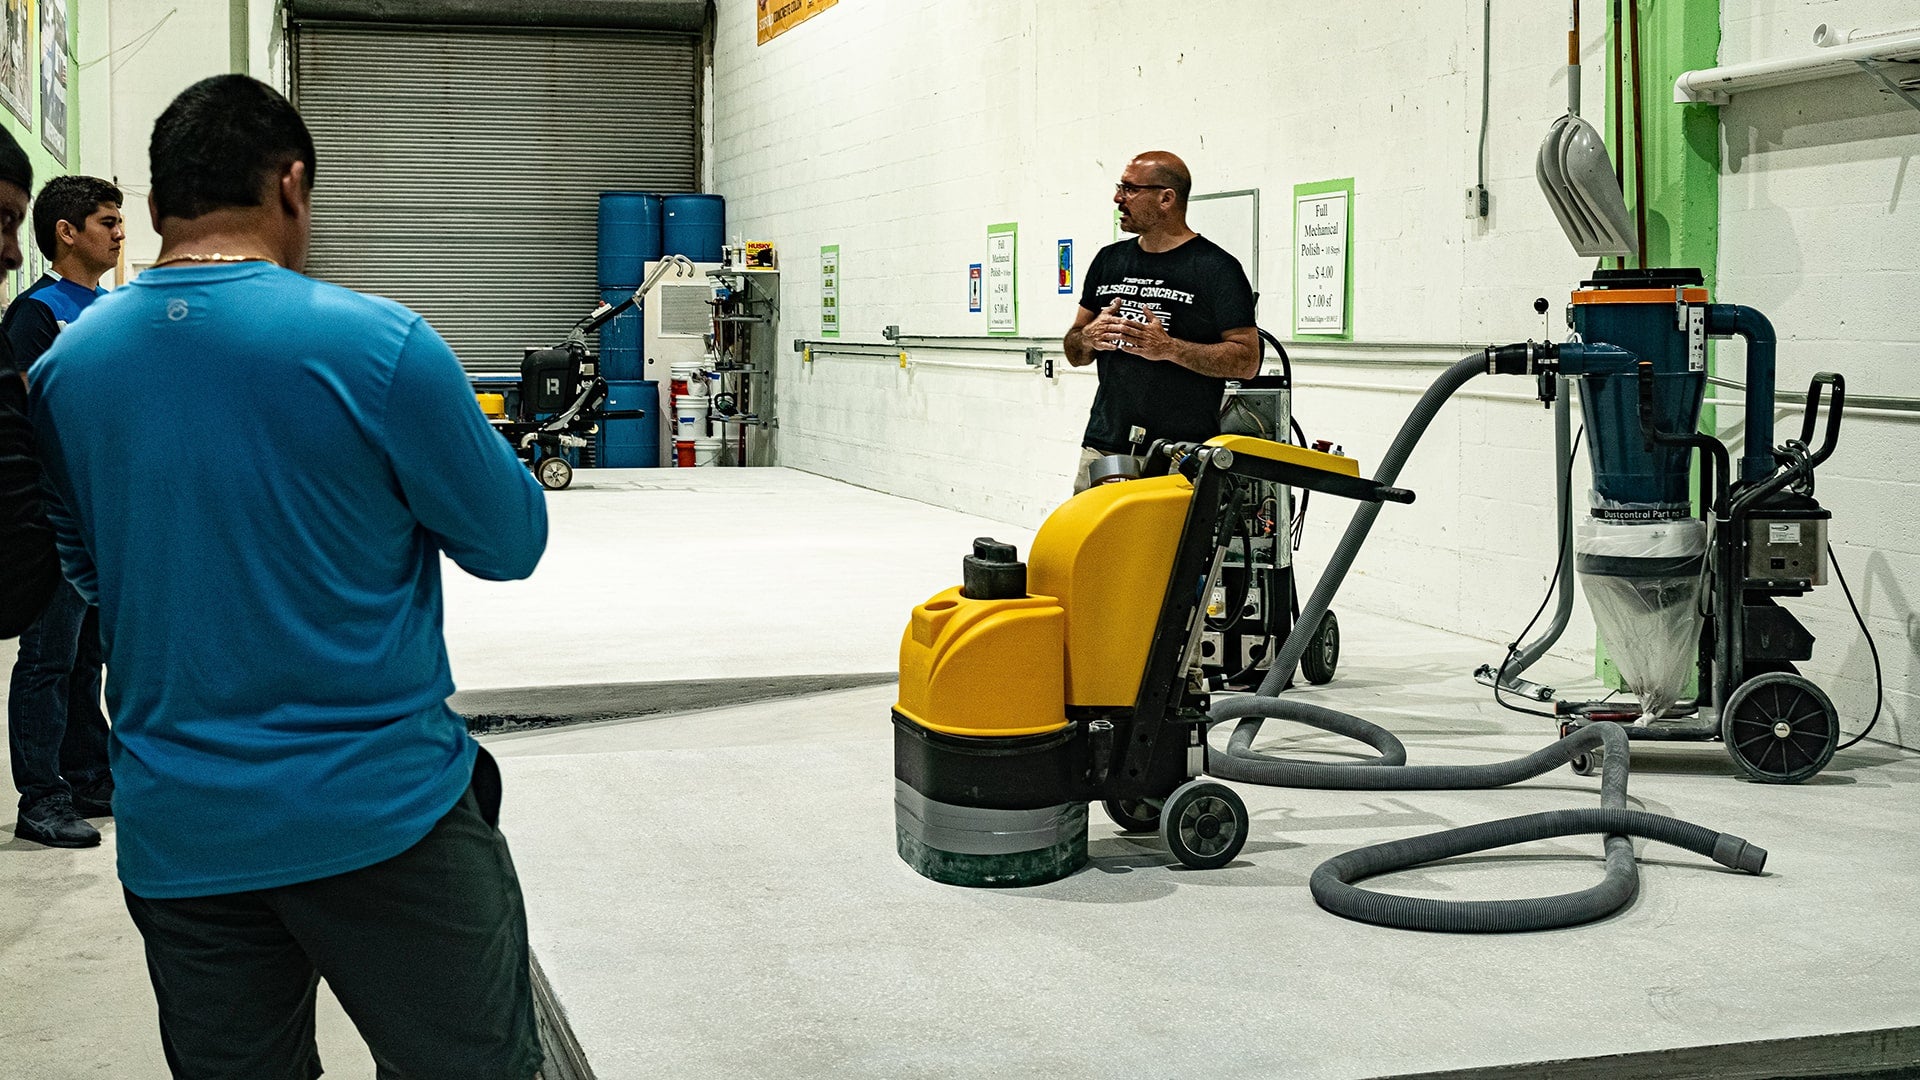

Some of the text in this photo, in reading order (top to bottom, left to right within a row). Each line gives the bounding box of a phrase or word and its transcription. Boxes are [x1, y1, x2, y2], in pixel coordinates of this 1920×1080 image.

[1316, 203, 1328, 217] Full
[1305, 222, 1338, 237] Mechanical
[1301, 243, 1320, 256] Polish
[1140, 286, 1195, 304] CONCRETE
[546, 378, 560, 395] R
[1604, 510, 1651, 519] Dustcontrol
[1652, 510, 1669, 518] Part
